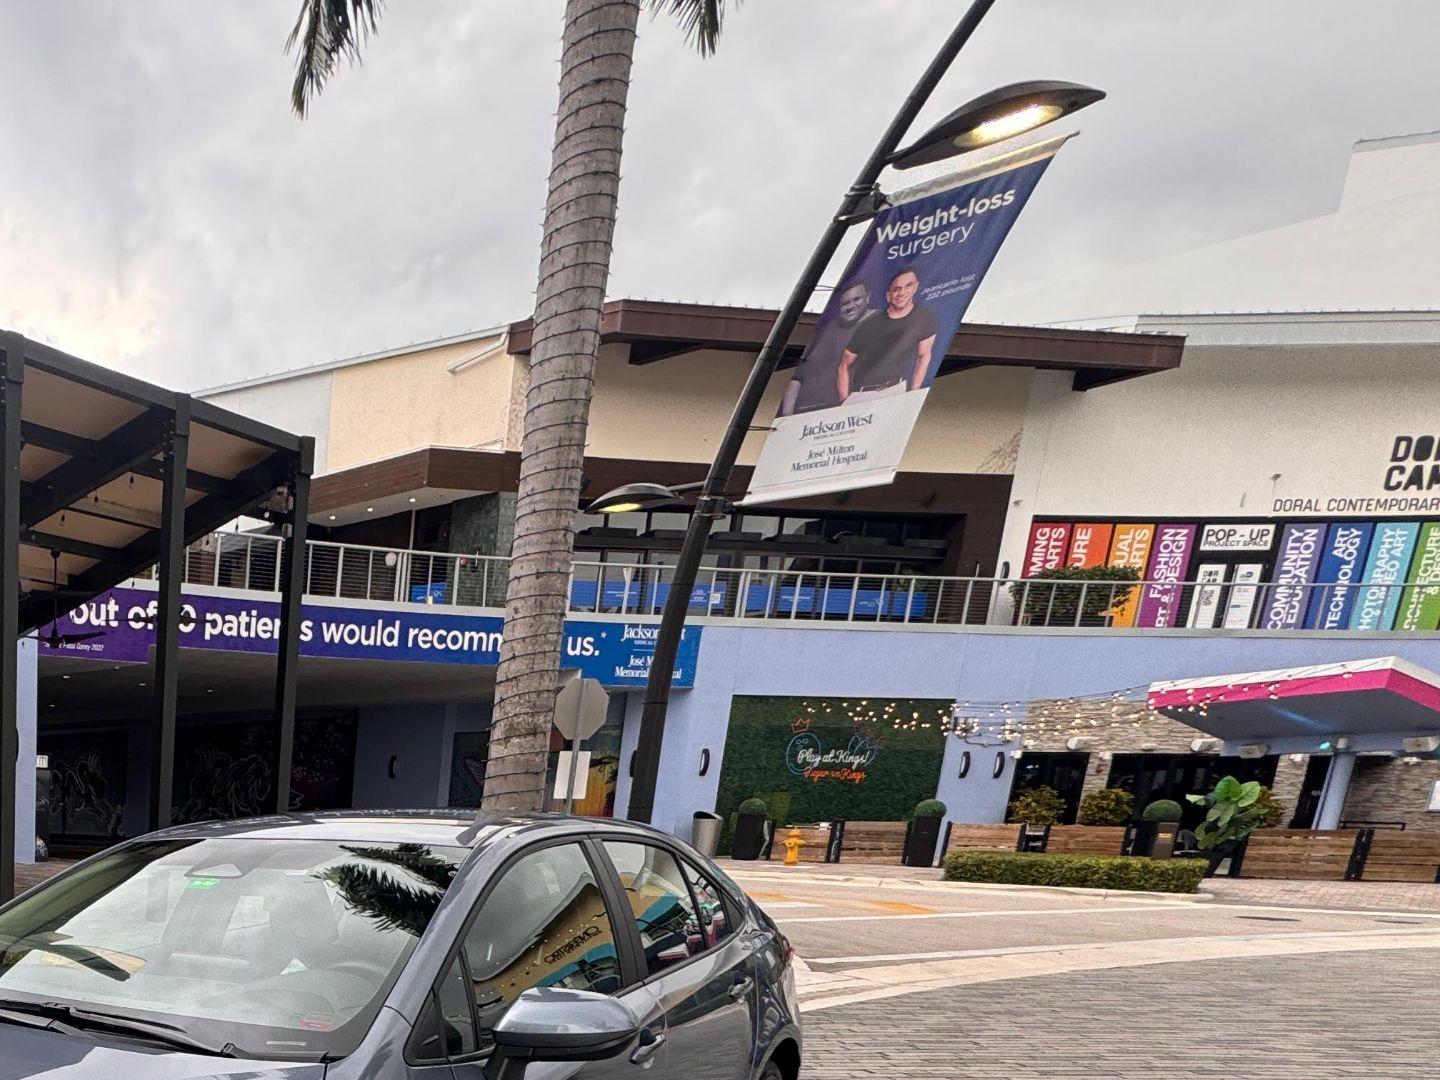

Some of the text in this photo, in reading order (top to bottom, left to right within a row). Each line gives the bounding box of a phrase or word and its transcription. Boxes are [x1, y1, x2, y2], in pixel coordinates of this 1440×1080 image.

[875, 189, 1016, 244] Weight-loss
[886, 221, 976, 260] surgery
[798, 413, 873, 441] Jackson West
[790, 450, 868, 472] Memorial Hospital
[1389, 435, 1440, 463] DO
[1272, 497, 1440, 512] DORAL CONTEMPORAR
[1027, 527, 1051, 577] MING
[1044, 527, 1066, 571] ARTS
[1073, 527, 1093, 570] URE
[1112, 528, 1135, 569] UAL
[1205, 528, 1237, 541] POP
[1249, 528, 1271, 541] UP
[1331, 527, 1351, 558] ART
[1390, 527, 1409, 558] ART
[1148, 528, 1178, 598] FASHION
[1162, 528, 1190, 589] DESIGN
[1267, 528, 1304, 630] COMMUNITY
[1324, 528, 1363, 630] TECHNOLOGY
[1357, 528, 1395, 630] HOTOGRAPHY
[69, 597, 119, 628] out
[178, 604, 197, 634] 0
[204, 608, 314, 642] paties
[321, 618, 401, 648] would
[407, 627, 504, 653] recomm
[614, 666, 650, 678] Memorial
[628, 655, 645, 668] José
[797, 748, 870, 770] Play at Kings!
